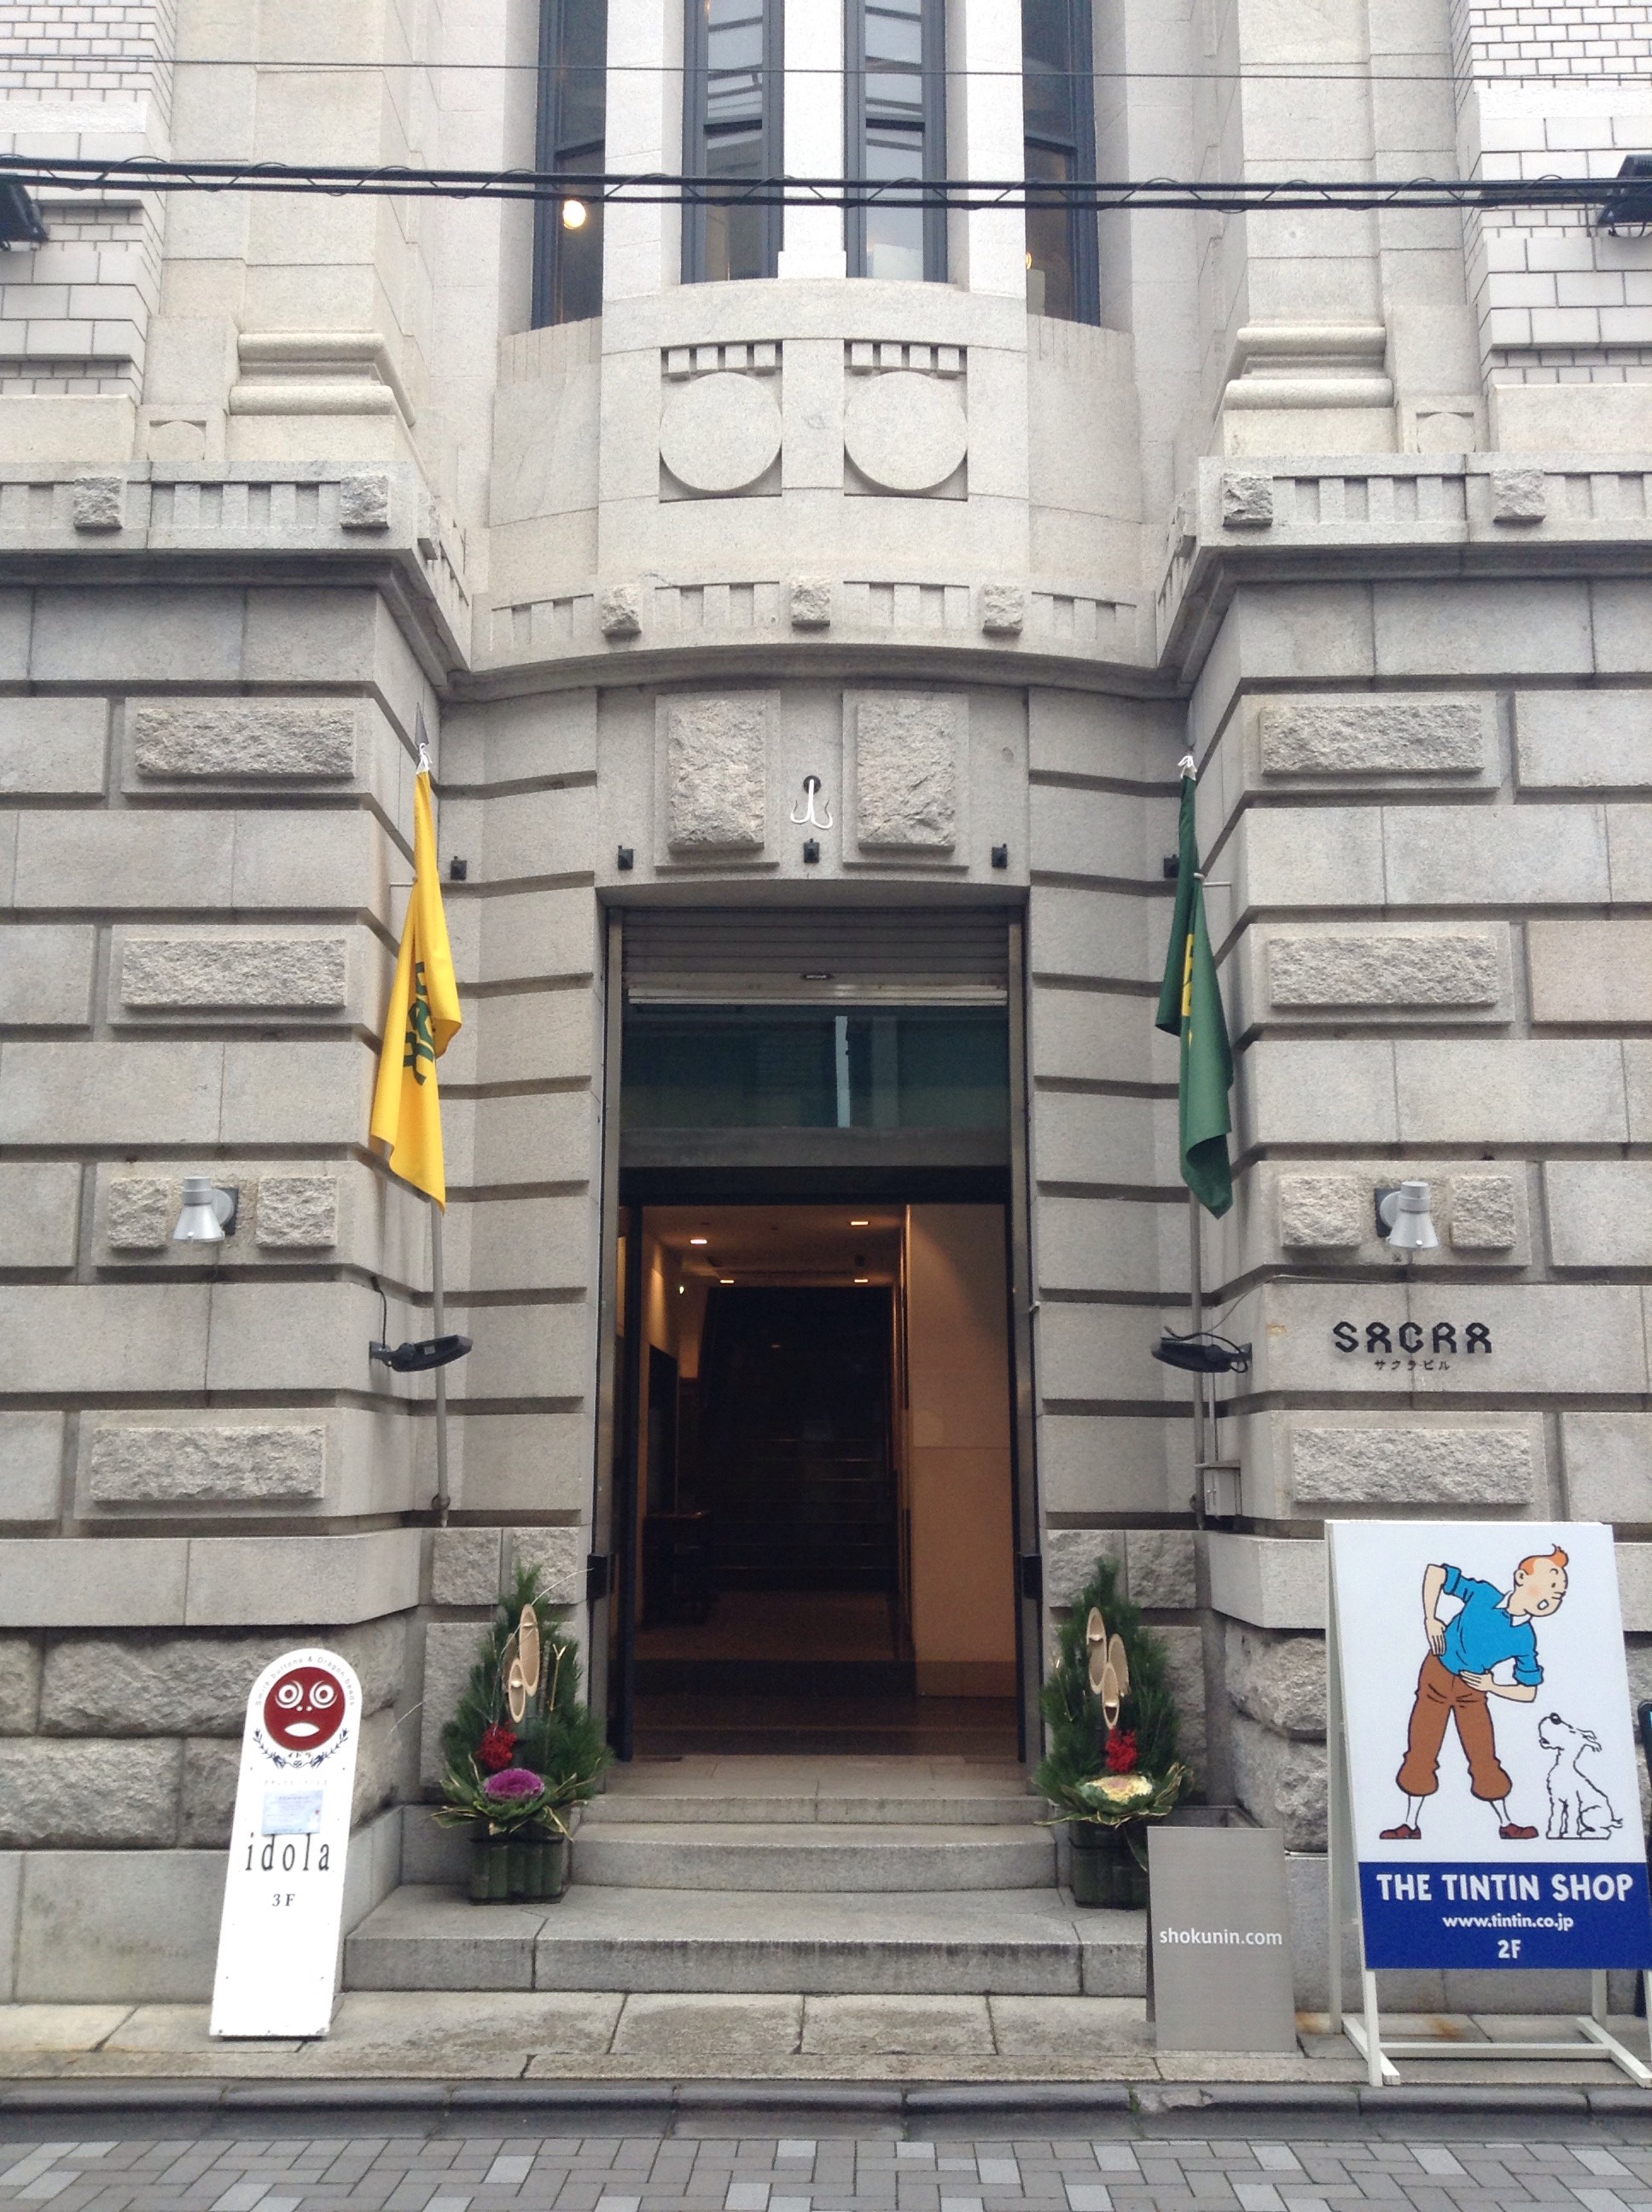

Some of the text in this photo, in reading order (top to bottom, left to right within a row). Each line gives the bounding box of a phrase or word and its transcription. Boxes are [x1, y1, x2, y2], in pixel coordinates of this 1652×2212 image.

[317, 1656, 345, 1677] Dragon
[245, 1831, 330, 1871] idola
[1376, 1874, 1633, 1901] THE TINTIN SHOP
[1442, 1912, 1574, 1931] www.tintin.co.jp
[1160, 1927, 1283, 1945] shokunin.com
[1498, 1939, 1521, 1959] 2F
